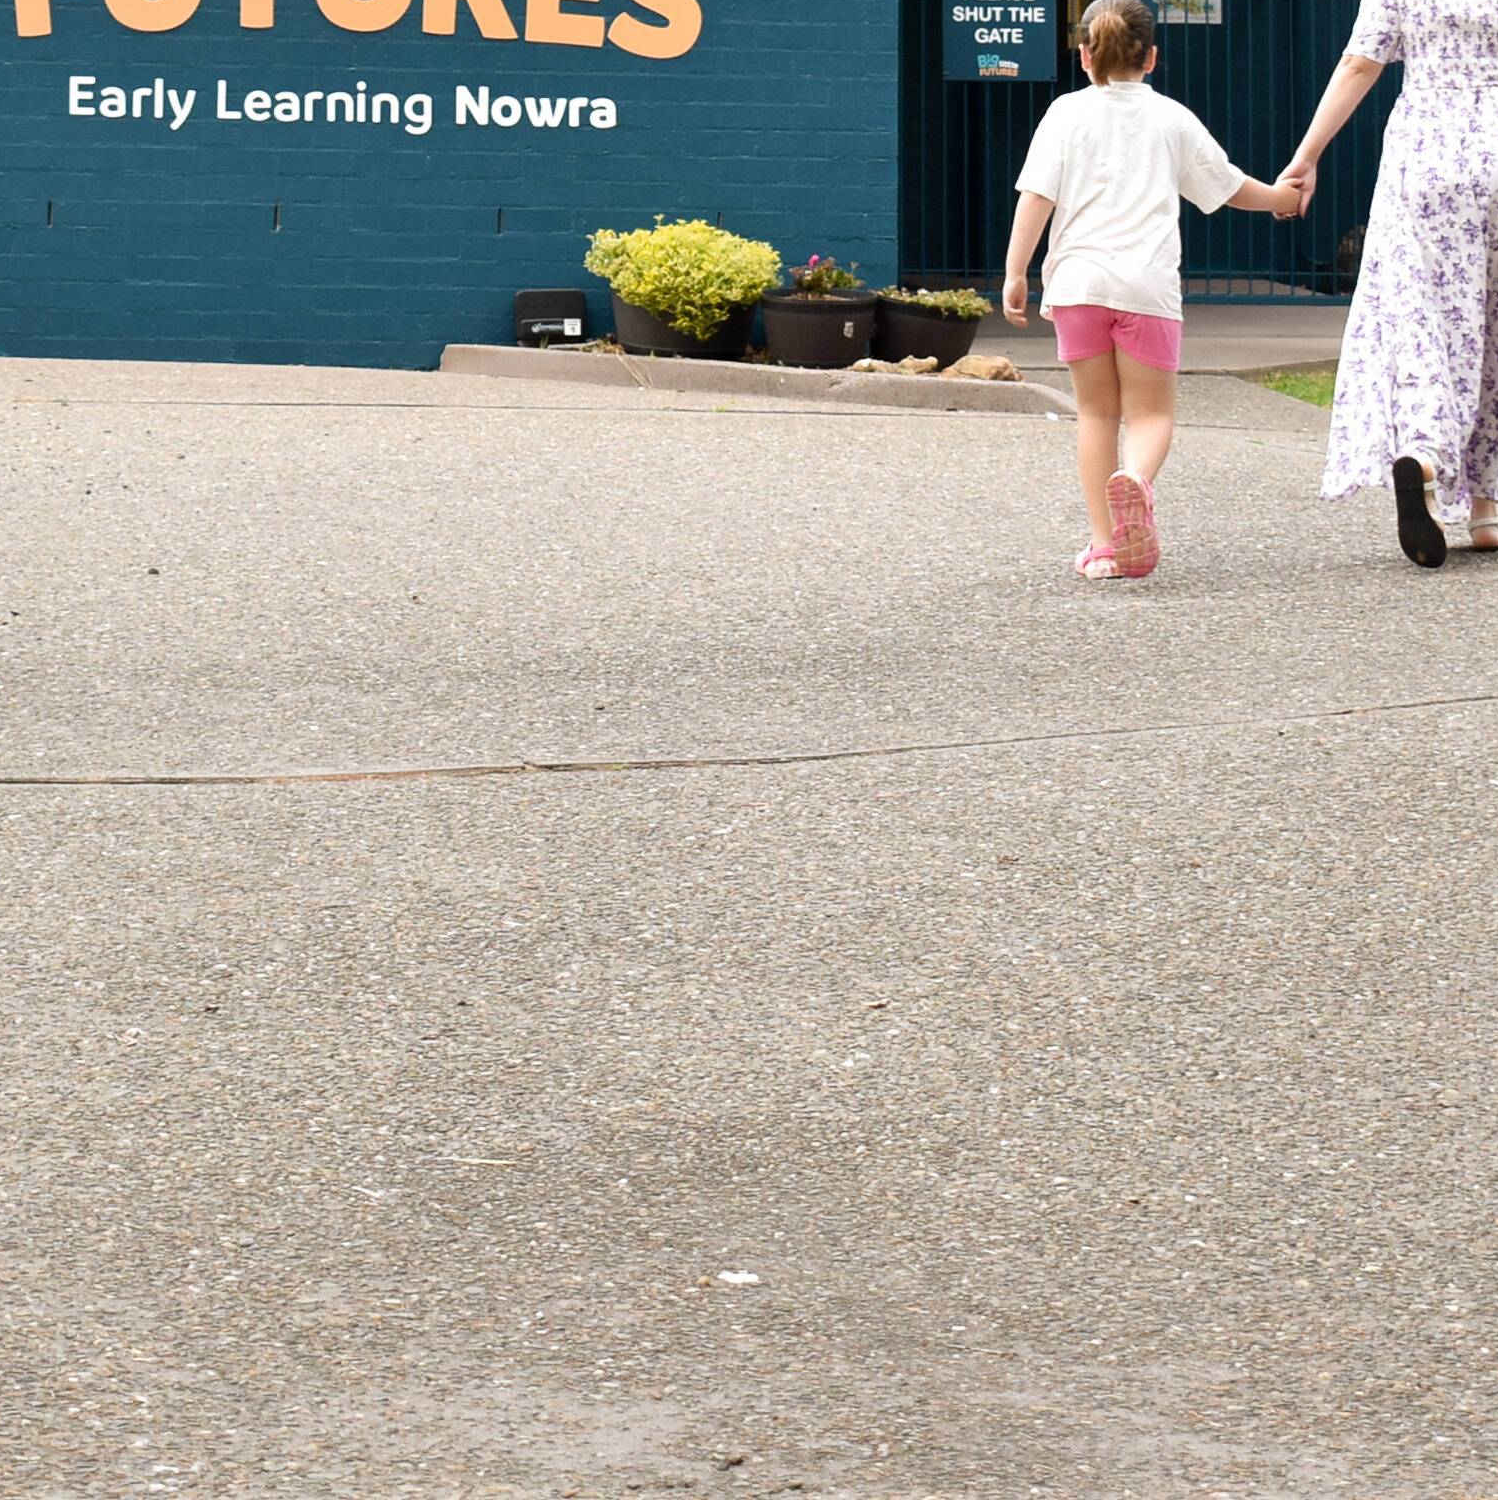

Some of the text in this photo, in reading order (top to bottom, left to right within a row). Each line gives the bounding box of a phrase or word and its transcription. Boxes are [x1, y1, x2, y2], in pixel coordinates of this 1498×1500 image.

[952, 6, 1046, 23] SHUT THE
[974, 28, 1024, 44] GATE
[977, 53, 1000, 68] Big
[68, 75, 617, 135] Early Learning Nowra
